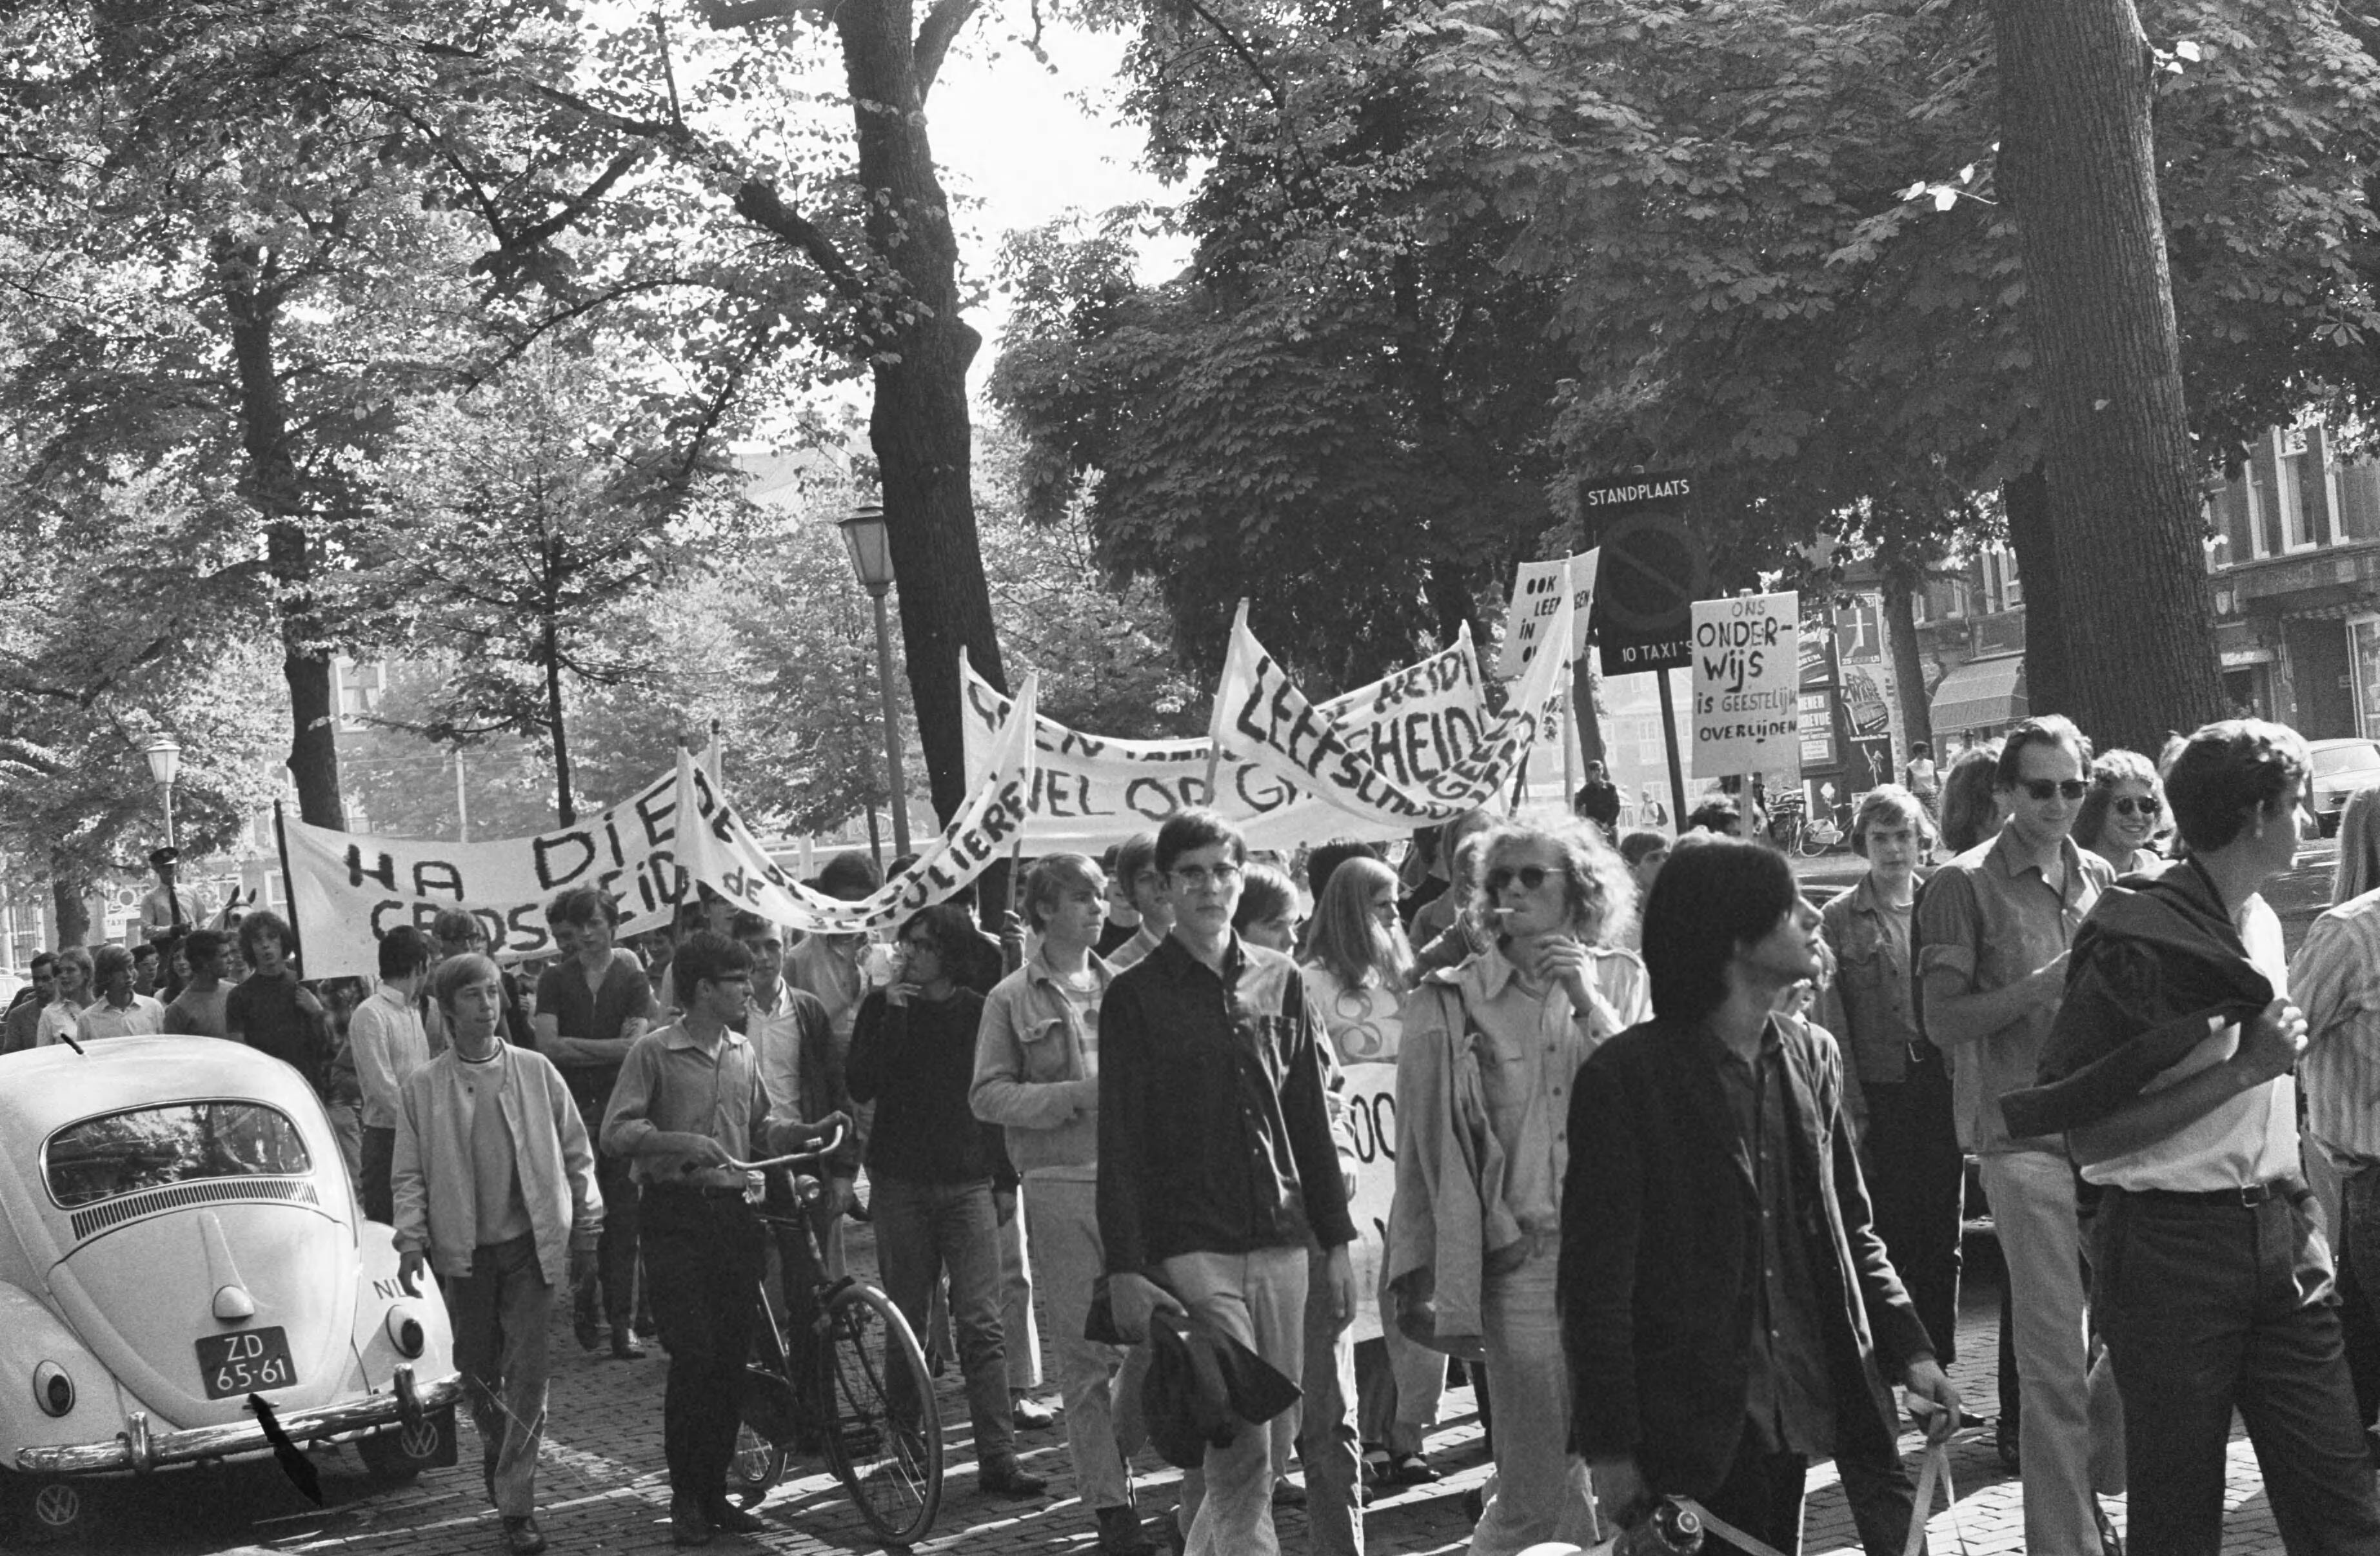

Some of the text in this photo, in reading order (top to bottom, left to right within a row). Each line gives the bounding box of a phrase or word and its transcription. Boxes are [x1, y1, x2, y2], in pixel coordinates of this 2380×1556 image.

[1588, 479, 1690, 506] STANDPLAATS
[1527, 575, 1558, 595] OOK
[1731, 599, 1765, 617] ONS
[1697, 616, 1793, 648] ONDER-
[1622, 648, 1636, 662] 10
[344, 843, 464, 901] HA
[224, 1334, 264, 1363] ZD
[216, 1357, 288, 1392] 65-61
